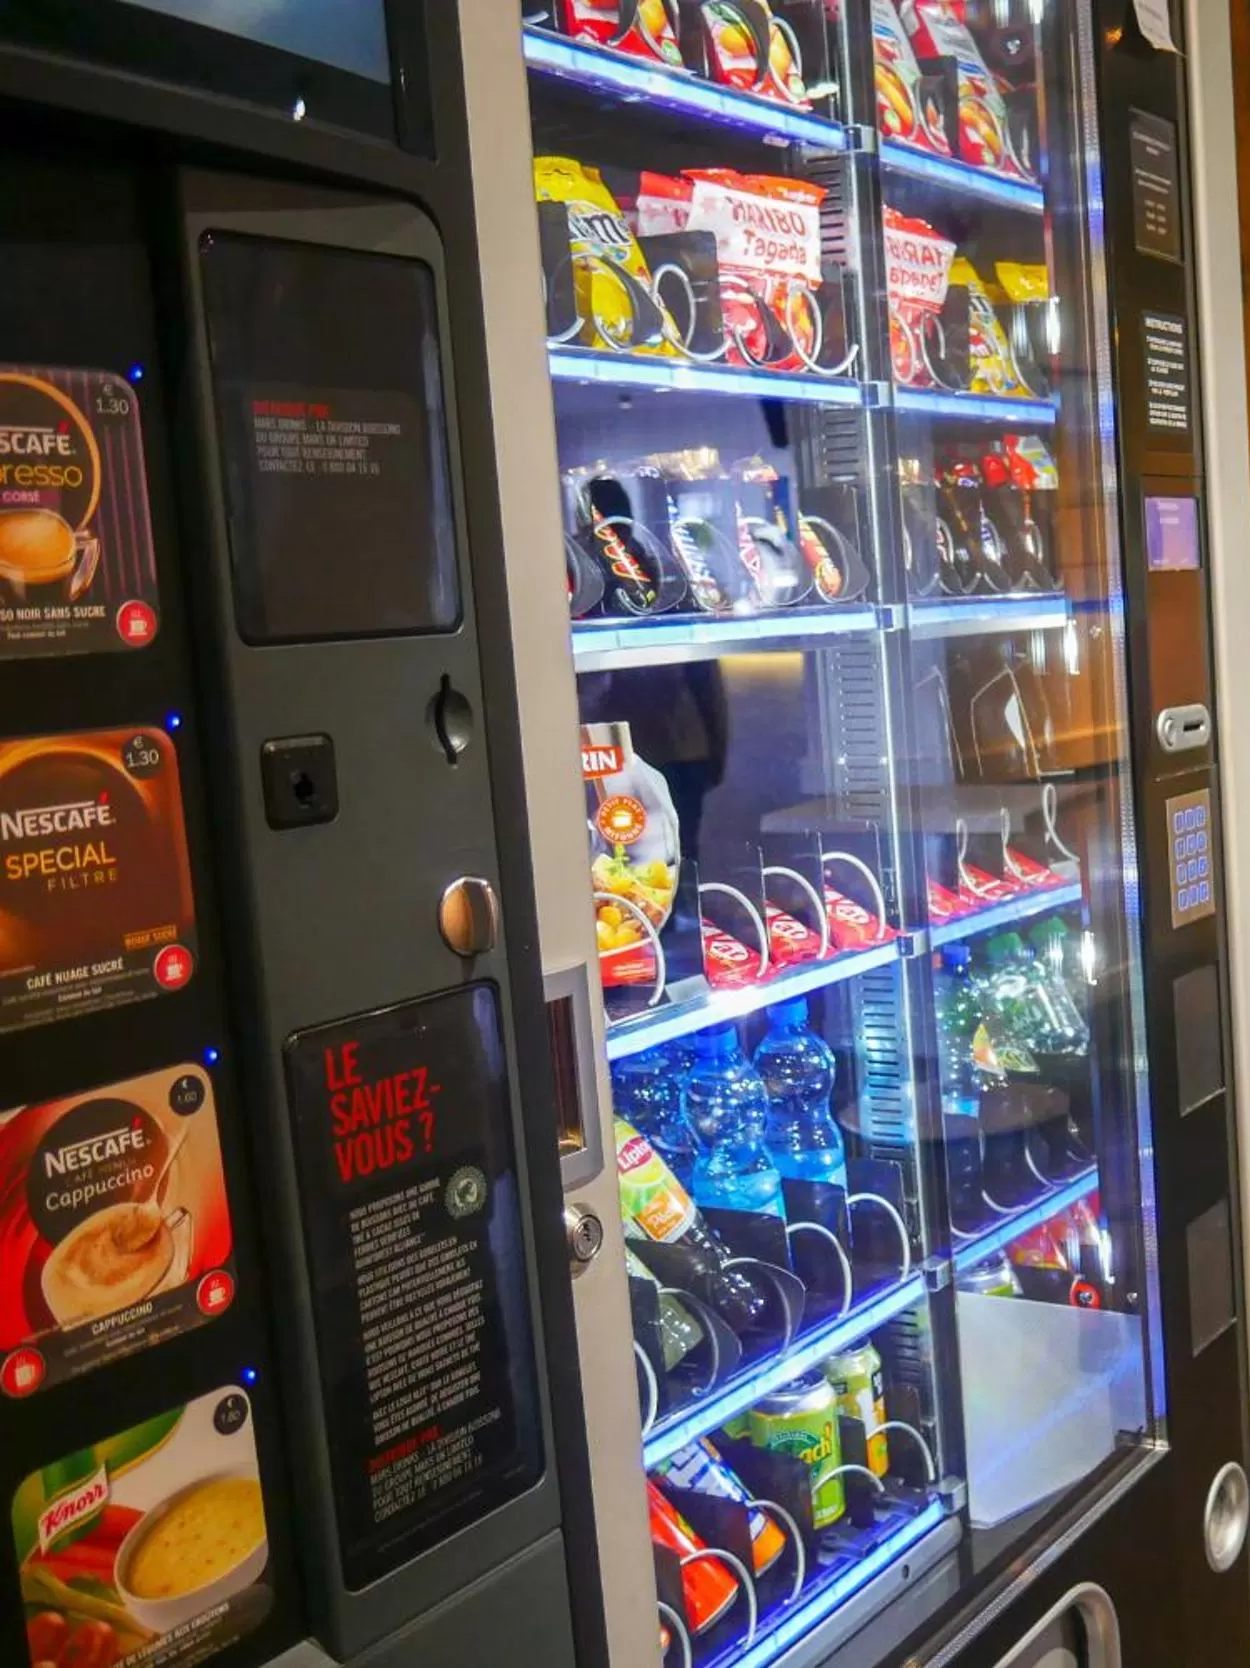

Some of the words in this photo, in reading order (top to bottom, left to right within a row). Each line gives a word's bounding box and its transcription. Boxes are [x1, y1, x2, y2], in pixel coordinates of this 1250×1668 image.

[724, 196, 806, 236] HARIBO
[743, 229, 807, 265] Tagada
[96, 397, 129, 415] 1.30
[0, 463, 83, 488] resso
[16, 607, 41, 621] NOIR
[43, 606, 71, 619] SANS
[126, 749, 160, 768] 1.30
[5, 841, 117, 881] SPECIAL
[47, 868, 119, 893] FILTRE
[55, 964, 90, 985] NUAGE
[325, 1041, 362, 1091] LE
[331, 1066, 441, 1136] SAVIEZ-
[334, 1118, 414, 1183] VOUS
[45, 1163, 155, 1211] Cappuccino
[92, 1302, 153, 1335] CAPPUCCINO
[44, 1484, 103, 1537] Knorr
